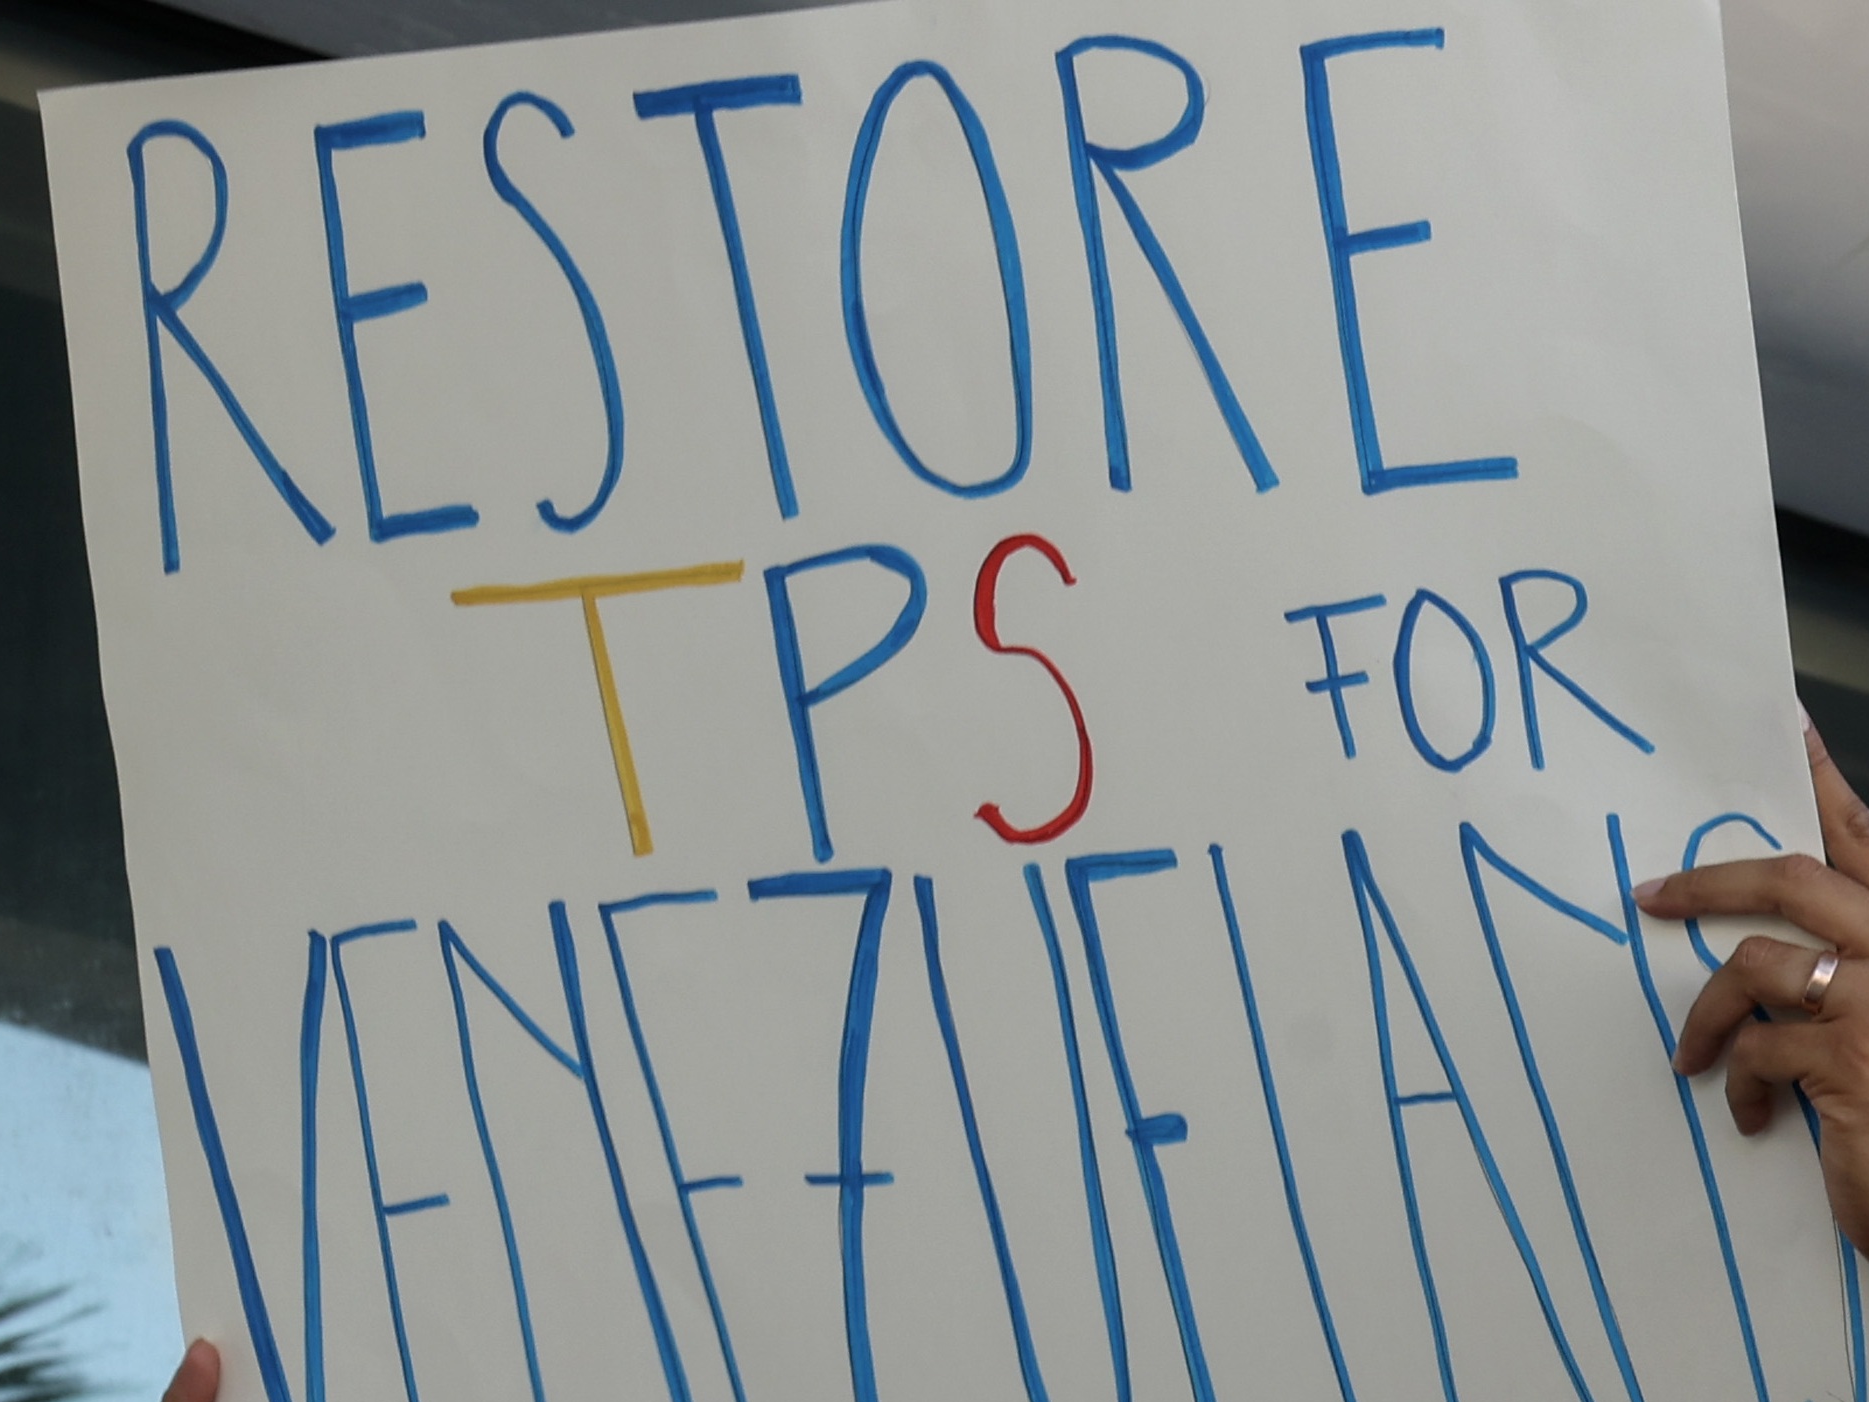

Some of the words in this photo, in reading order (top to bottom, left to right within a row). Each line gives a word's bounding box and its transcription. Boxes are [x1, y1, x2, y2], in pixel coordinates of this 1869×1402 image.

[128, 28, 1518, 573] RESTORE
[452, 534, 1093, 861] TPS
[1285, 569, 1654, 771] FOR
